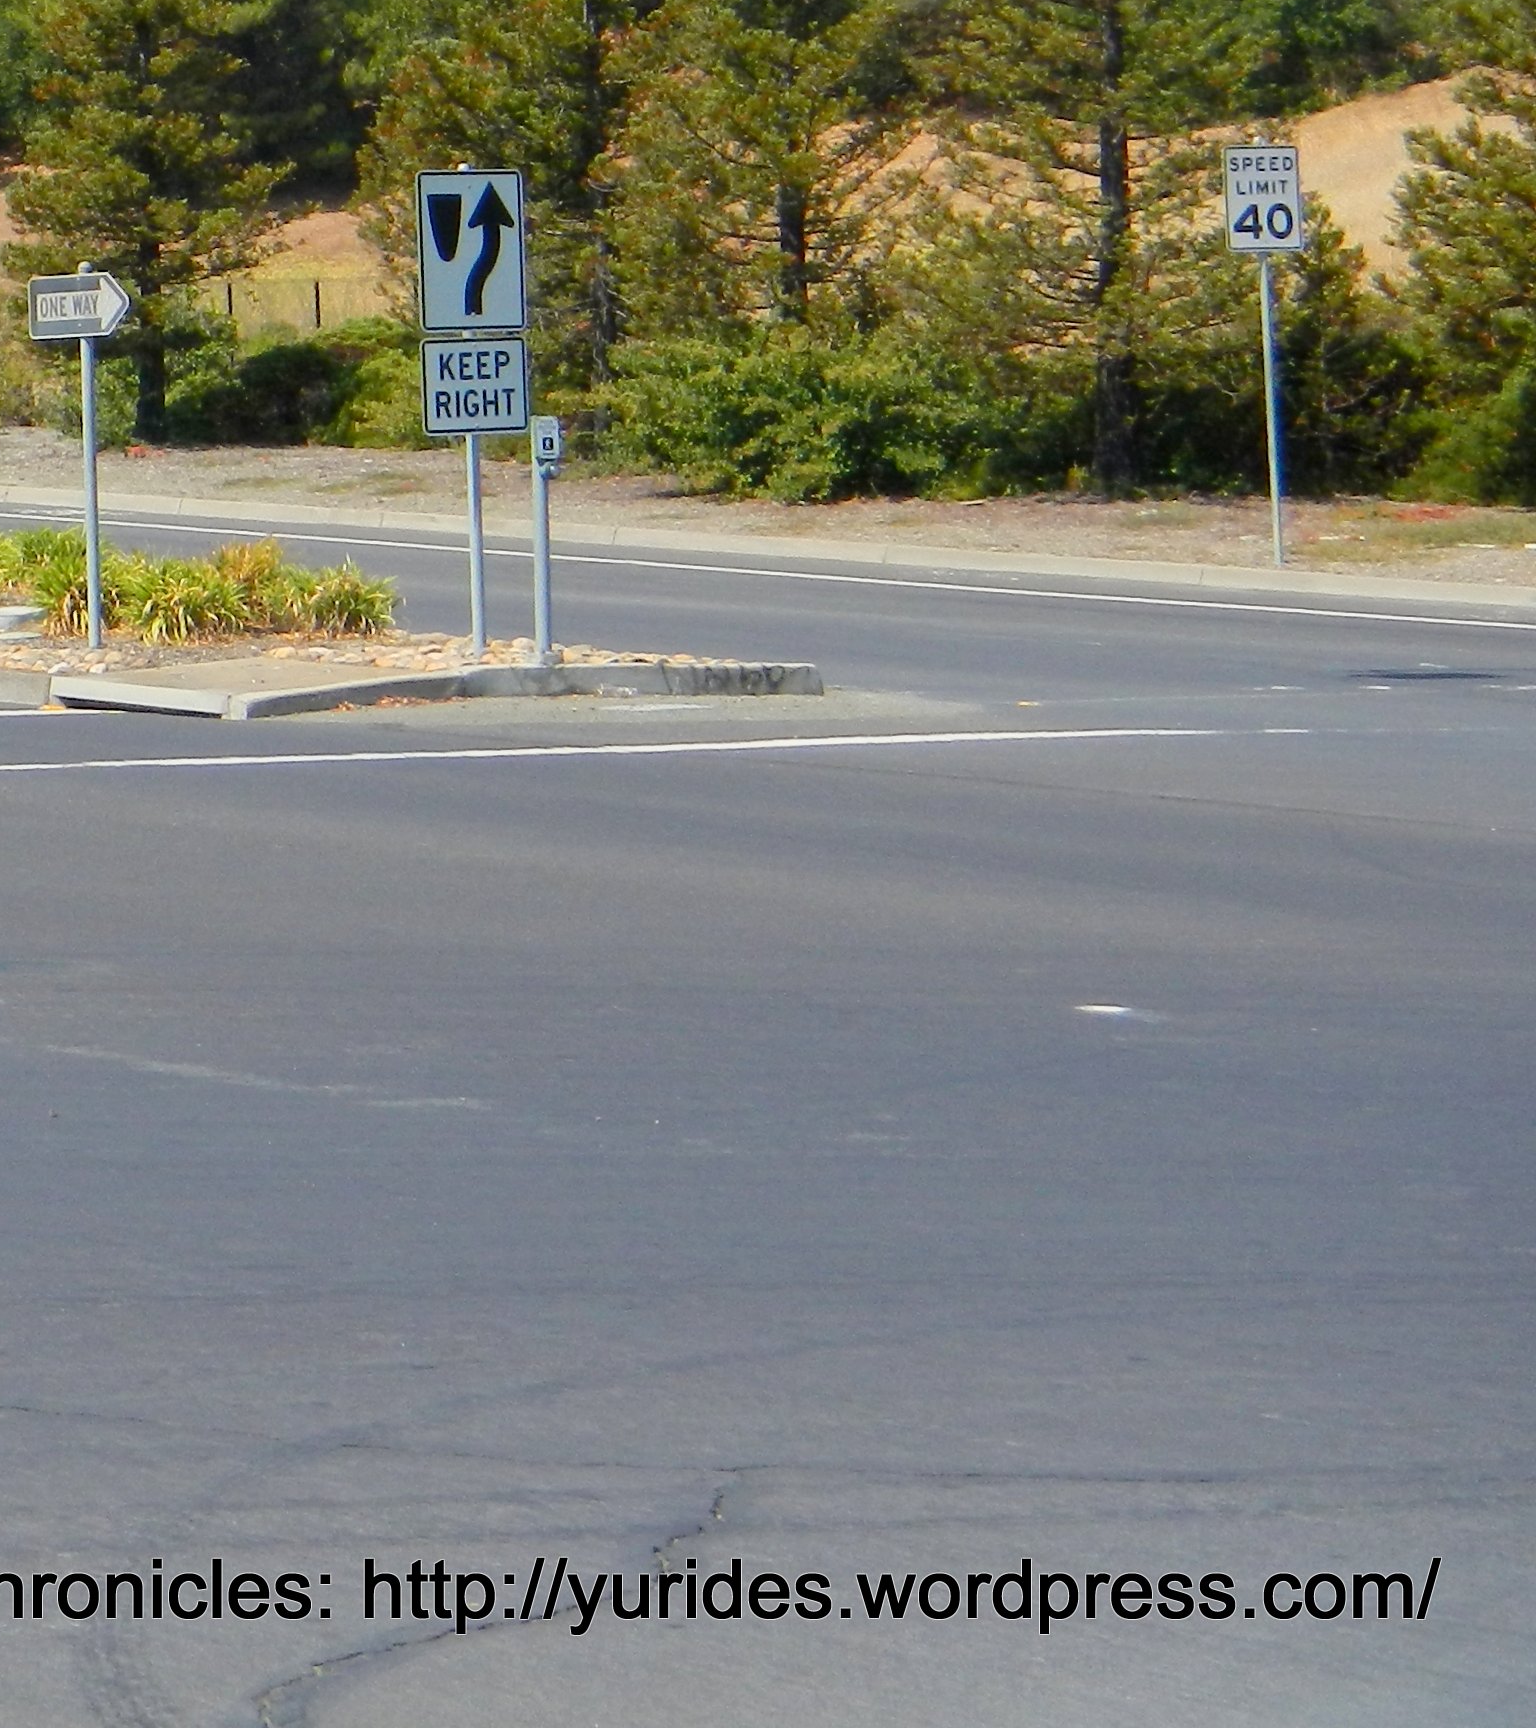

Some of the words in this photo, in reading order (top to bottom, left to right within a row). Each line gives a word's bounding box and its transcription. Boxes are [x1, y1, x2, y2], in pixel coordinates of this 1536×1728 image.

[1230, 156, 1293, 172] SPEED
[1236, 180, 1288, 195] LIMIT
[1233, 203, 1293, 240] 40
[40, 295, 67, 318] ONE
[72, 293, 99, 317] WAY
[439, 350, 510, 381] KEEP
[435, 388, 516, 419] RIGHT
